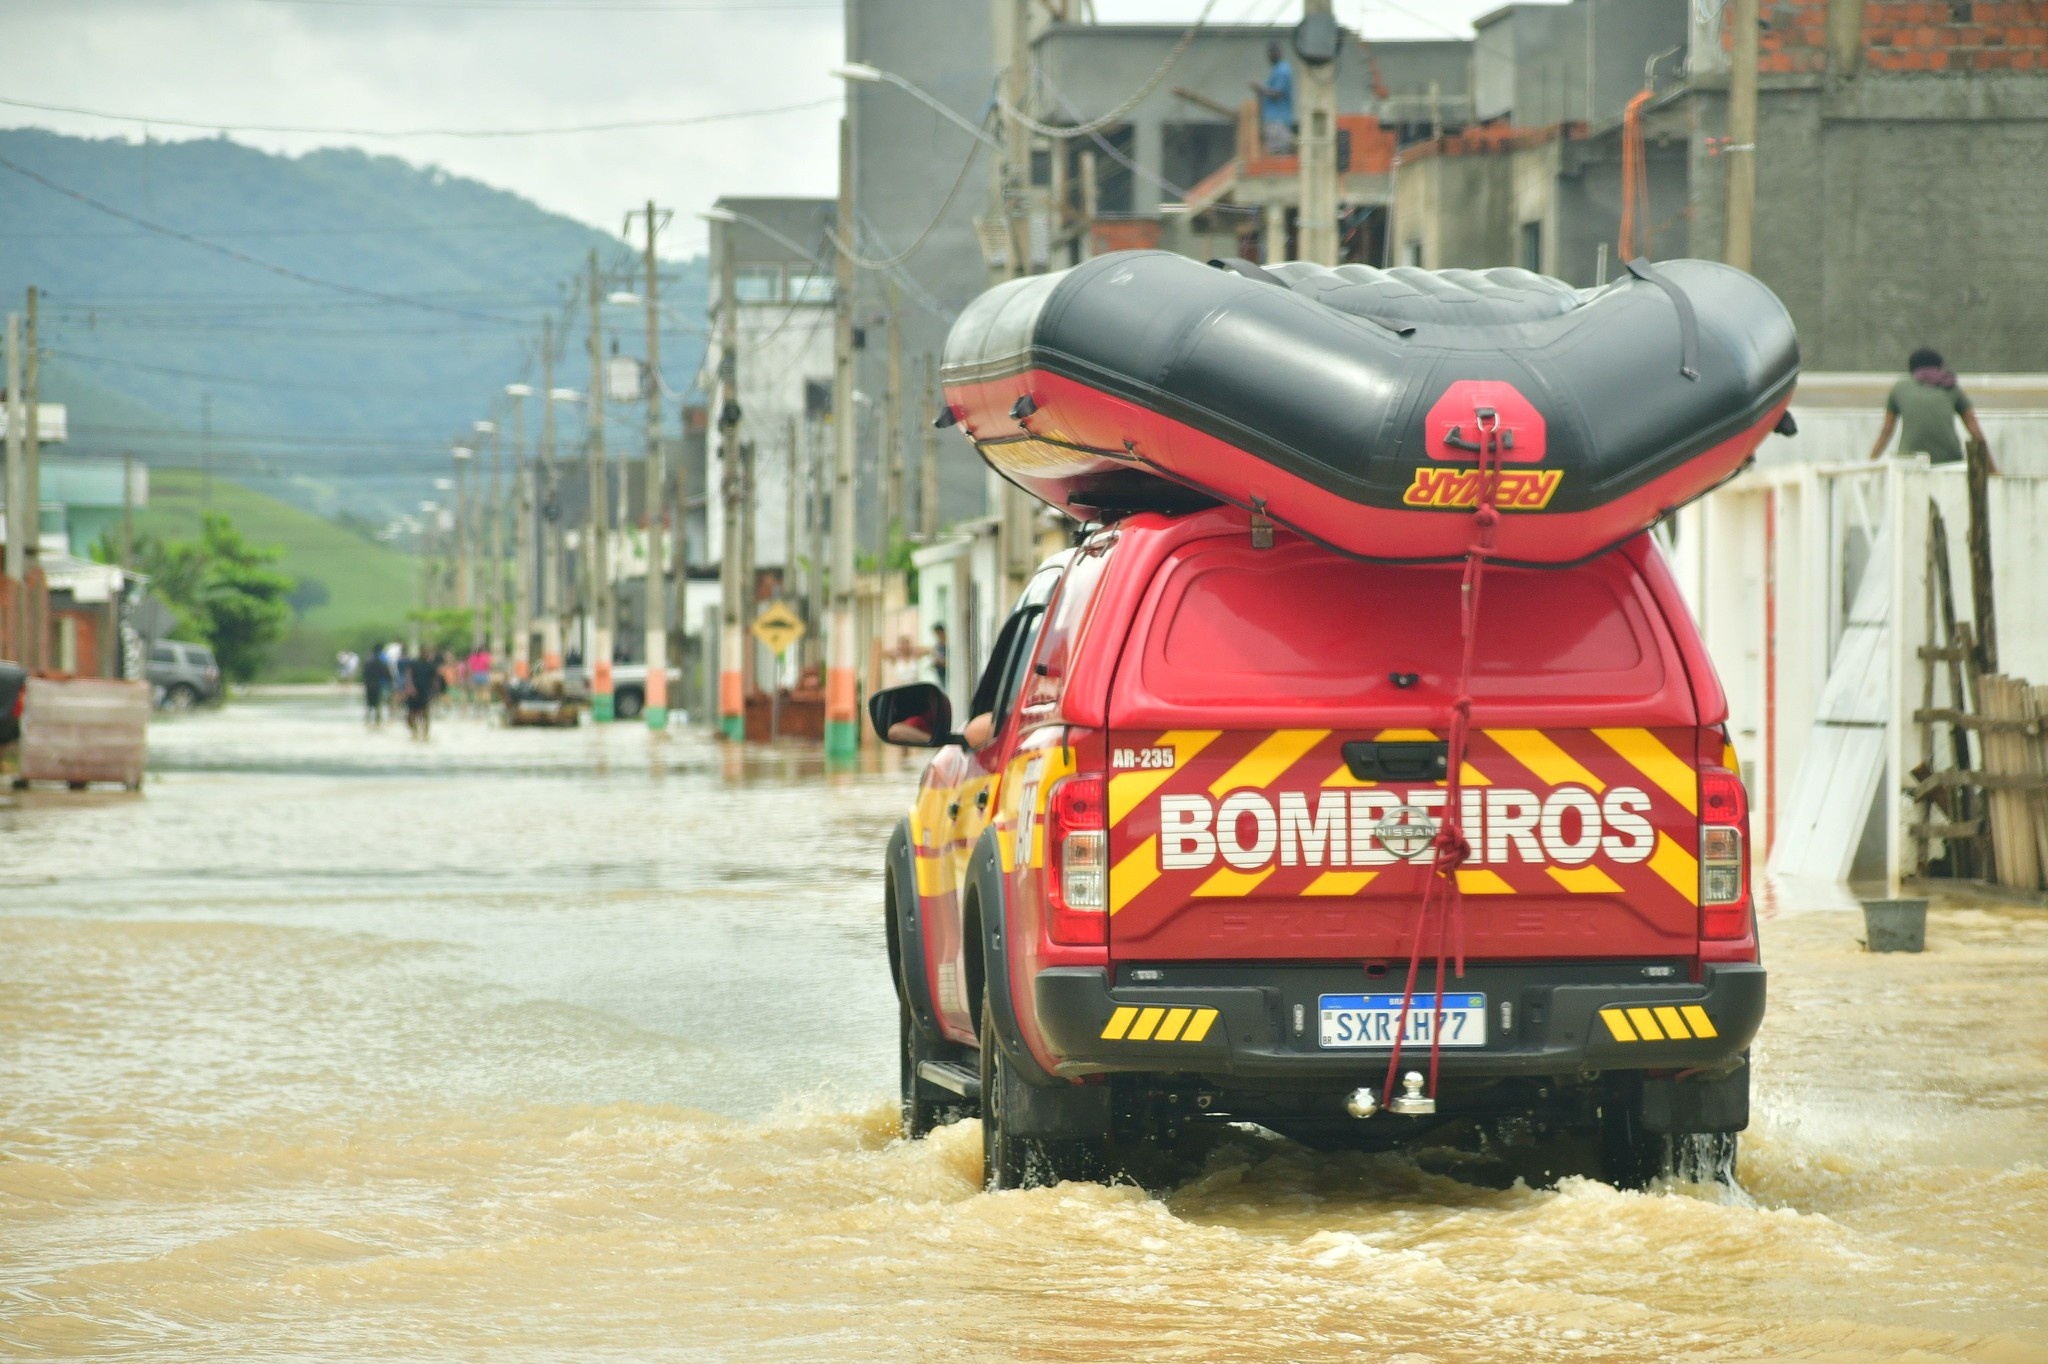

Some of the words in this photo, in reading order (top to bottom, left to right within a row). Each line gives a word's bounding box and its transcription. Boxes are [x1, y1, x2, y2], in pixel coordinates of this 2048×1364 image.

[1113, 748, 1174, 768] AR-235
[1160, 786, 1655, 870] BOMBEIROS
[1375, 828, 1435, 837] NISSAN
[1388, 998, 1416, 1006] BRAL
